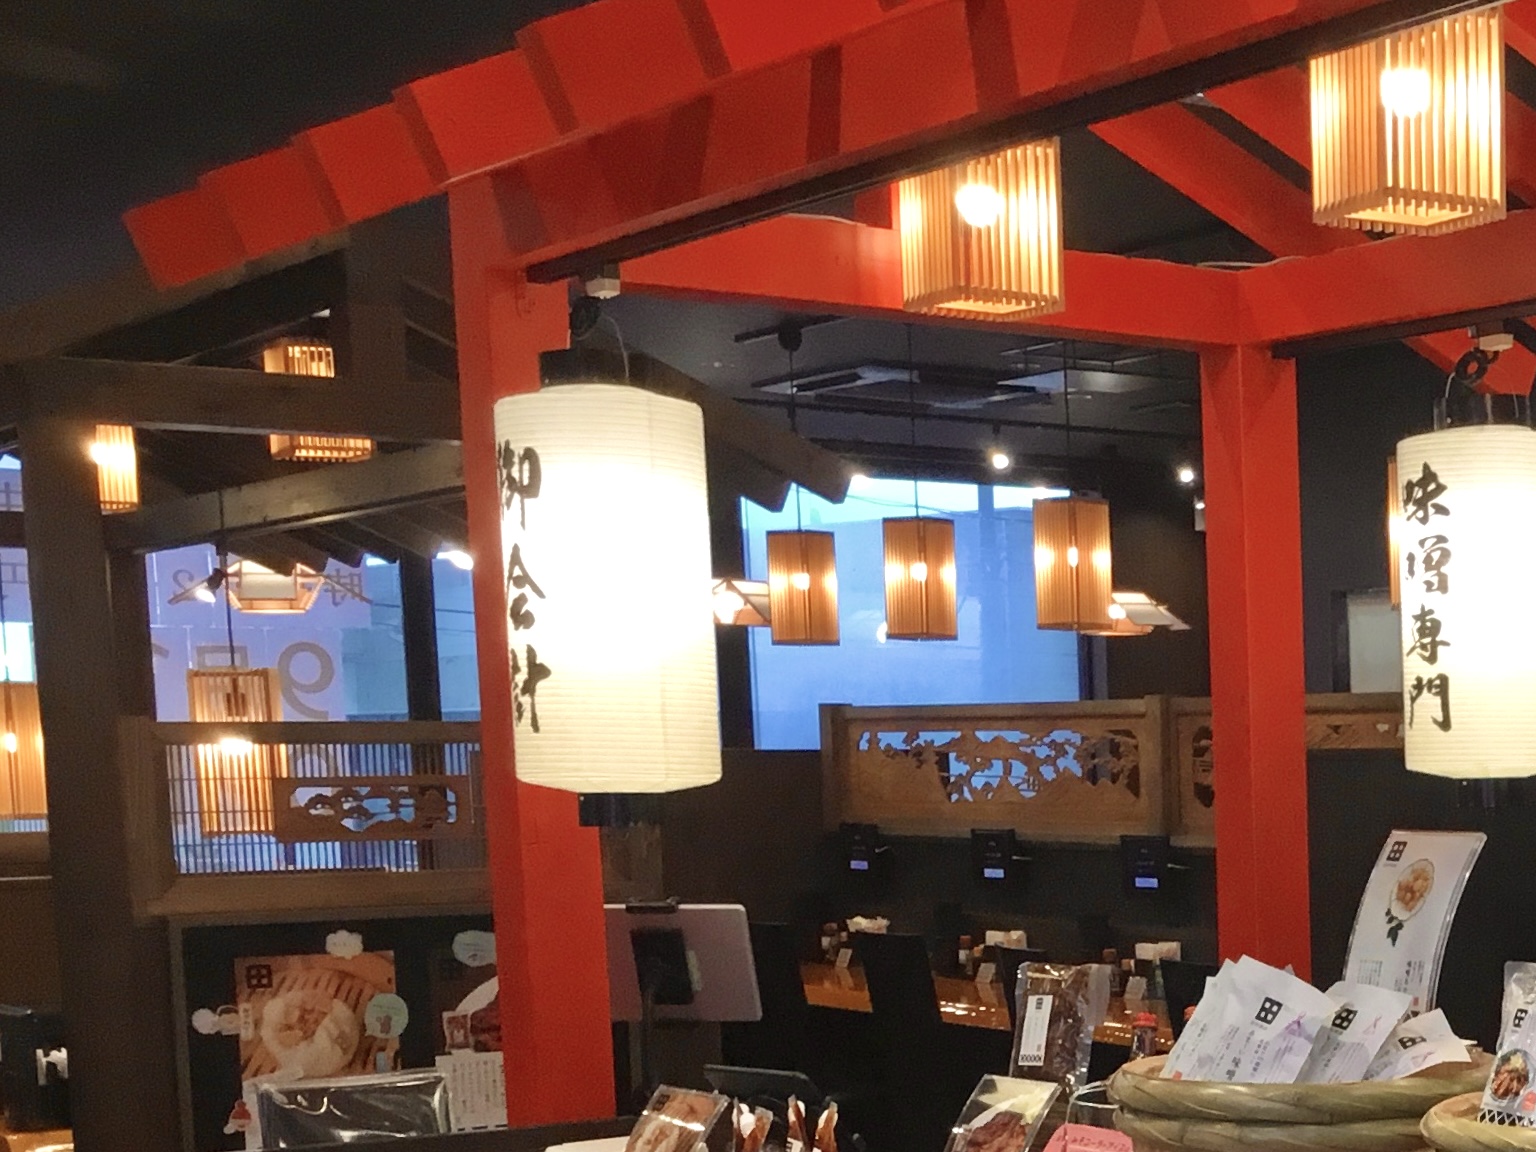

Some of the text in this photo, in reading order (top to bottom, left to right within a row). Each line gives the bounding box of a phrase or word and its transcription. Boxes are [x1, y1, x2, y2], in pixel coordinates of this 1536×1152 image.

[497, 439, 552, 733] 御会計
[1402, 461, 1452, 732] 味噌専門
